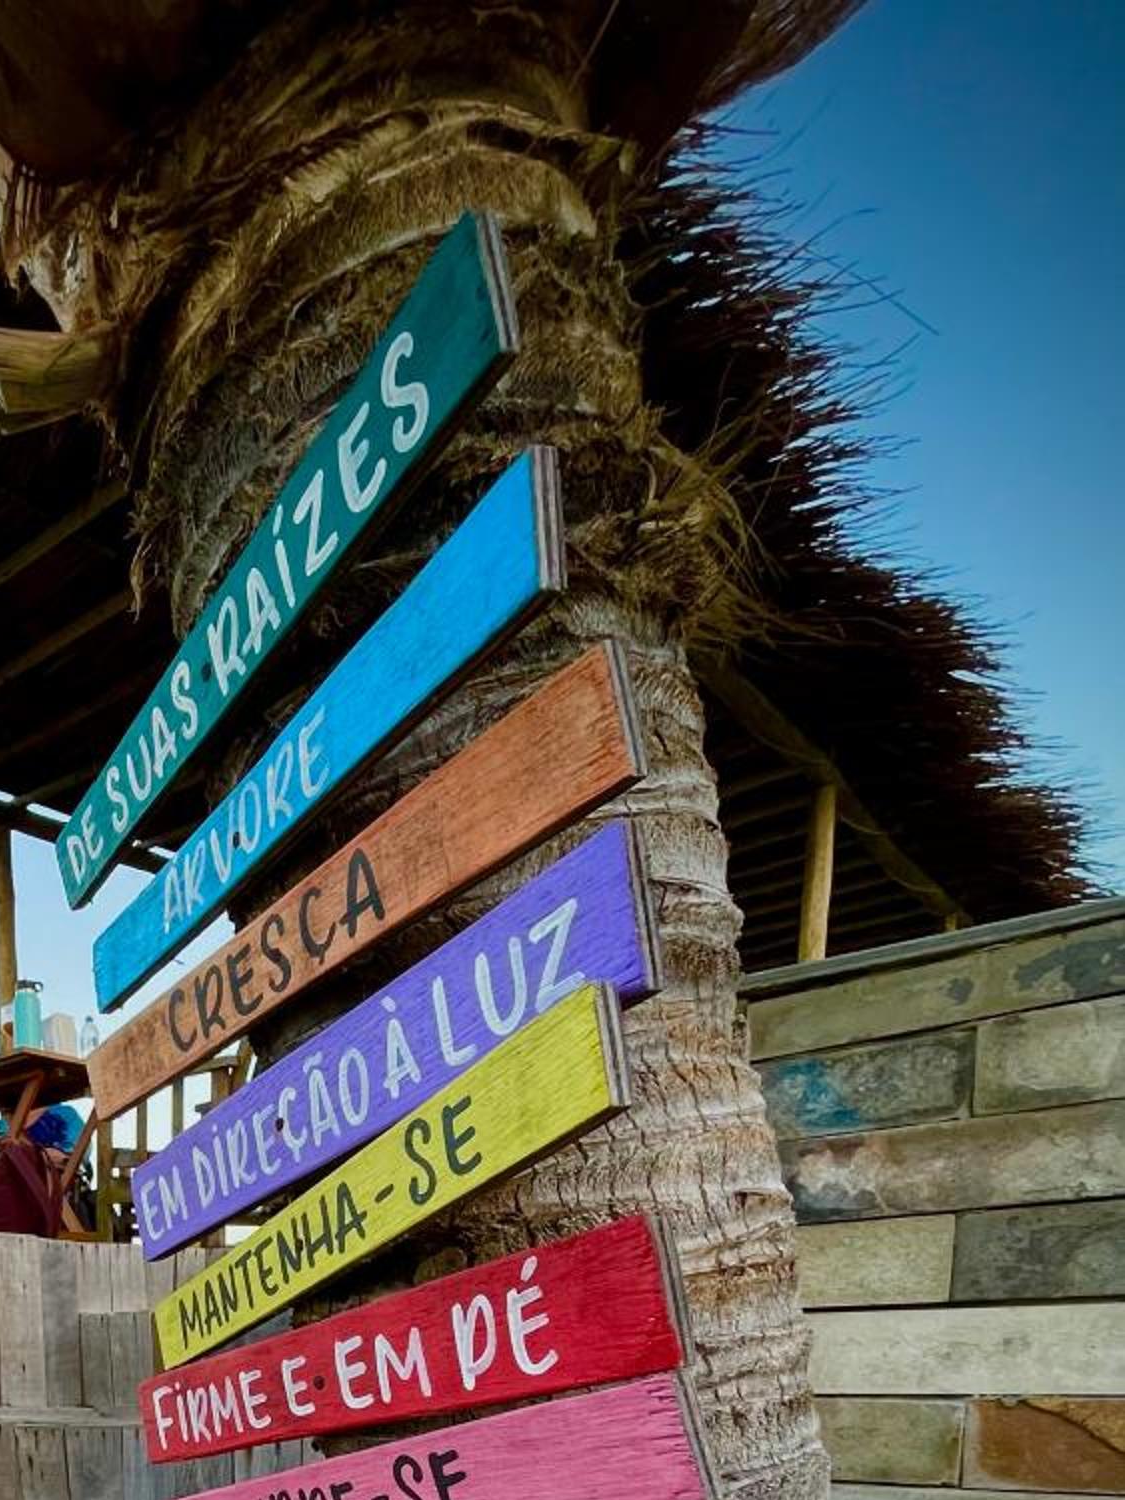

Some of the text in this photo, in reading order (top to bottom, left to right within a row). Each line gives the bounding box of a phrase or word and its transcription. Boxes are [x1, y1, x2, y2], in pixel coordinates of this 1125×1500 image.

[67, 817, 104, 885] DE
[105, 660, 200, 833] SUAS
[167, 847, 385, 1053] CRESÇA
[140, 1176, 189, 1243] EM
[382, 996, 422, 1099] À
[432, 897, 586, 1068] LUZ
[179, 1095, 482, 1349] MANTENHA-SE
[281, 1355, 315, 1416] E
[334, 1326, 432, 1411] EM
[451, 1255, 559, 1393] PÉ
